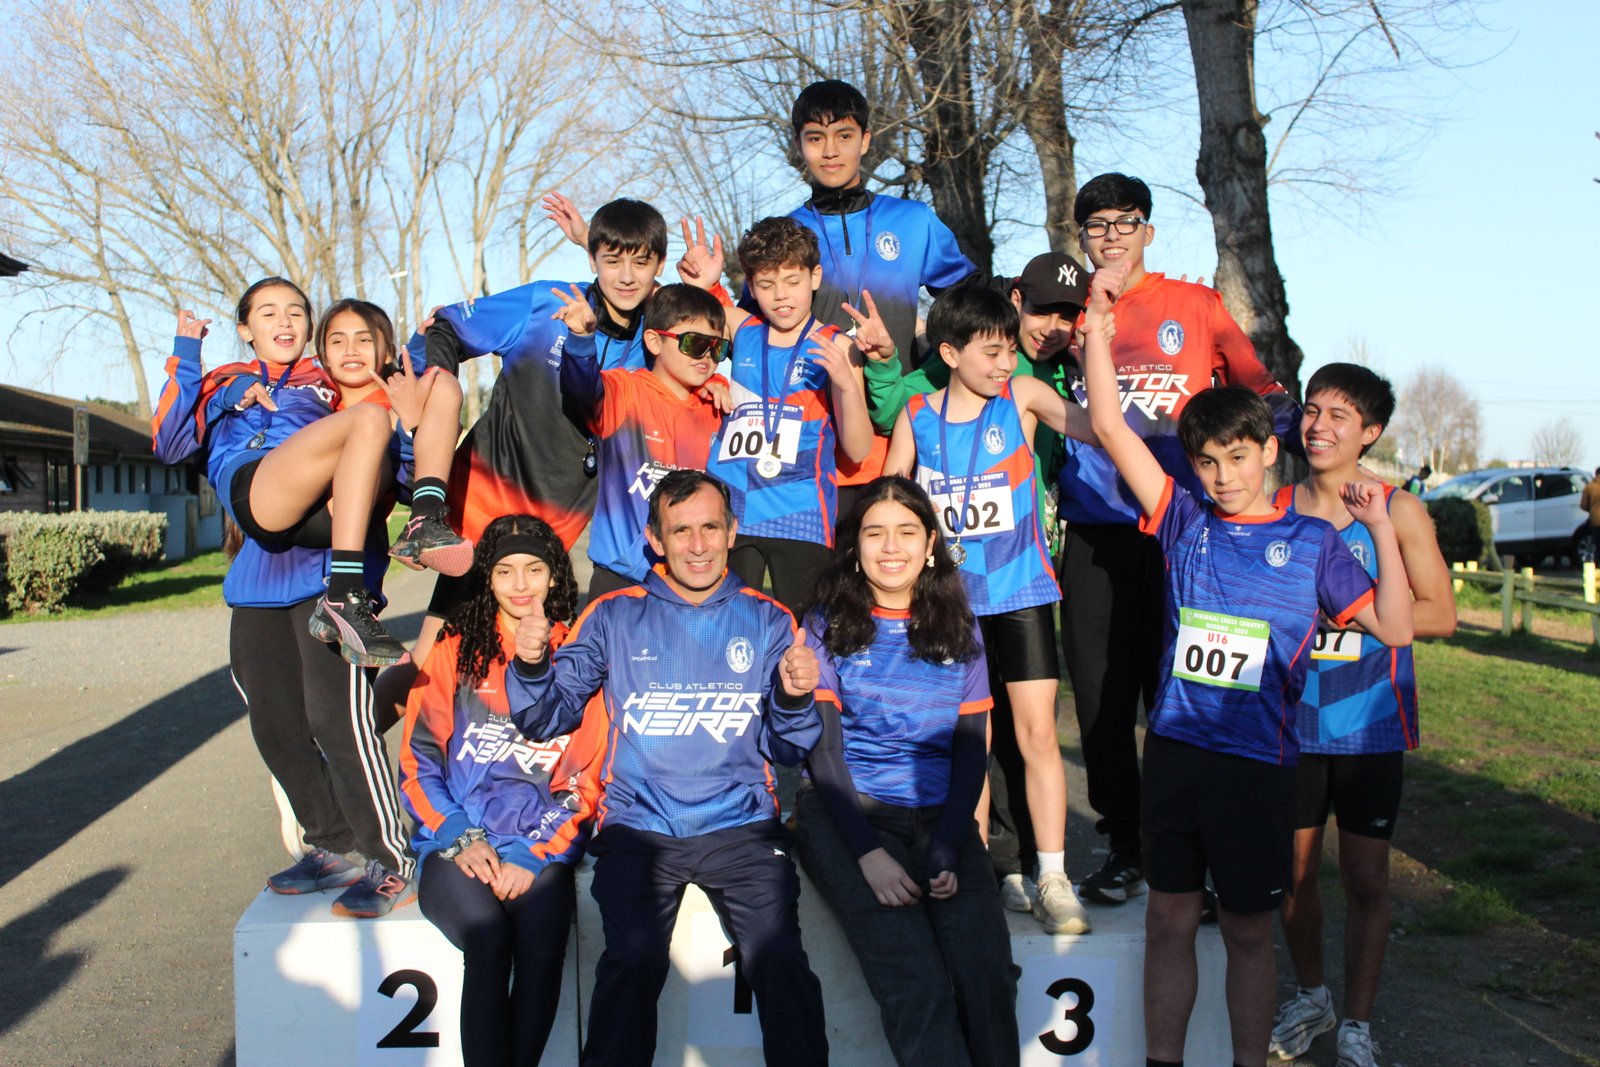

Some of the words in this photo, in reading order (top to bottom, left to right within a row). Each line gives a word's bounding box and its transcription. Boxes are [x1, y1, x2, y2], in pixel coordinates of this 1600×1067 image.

[1119, 364, 1173, 372] ATLETICO
[728, 430, 782, 459] 001
[653, 461, 678, 470] CLUB
[957, 493, 975, 503] U4
[943, 501, 1001, 533] 002
[1239, 620, 1265, 630] COUNTRY
[1207, 633, 1228, 645] U16
[1185, 644, 1249, 681] 007
[649, 681, 682, 690] CLUB
[685, 682, 743, 691] ATLETICO
[622, 691, 762, 716] HECTOR
[622, 711, 753, 743] NEIRA
[456, 740, 562, 774] NEIRA
[377, 969, 440, 1048] 2
[1039, 978, 1095, 1056] 3
